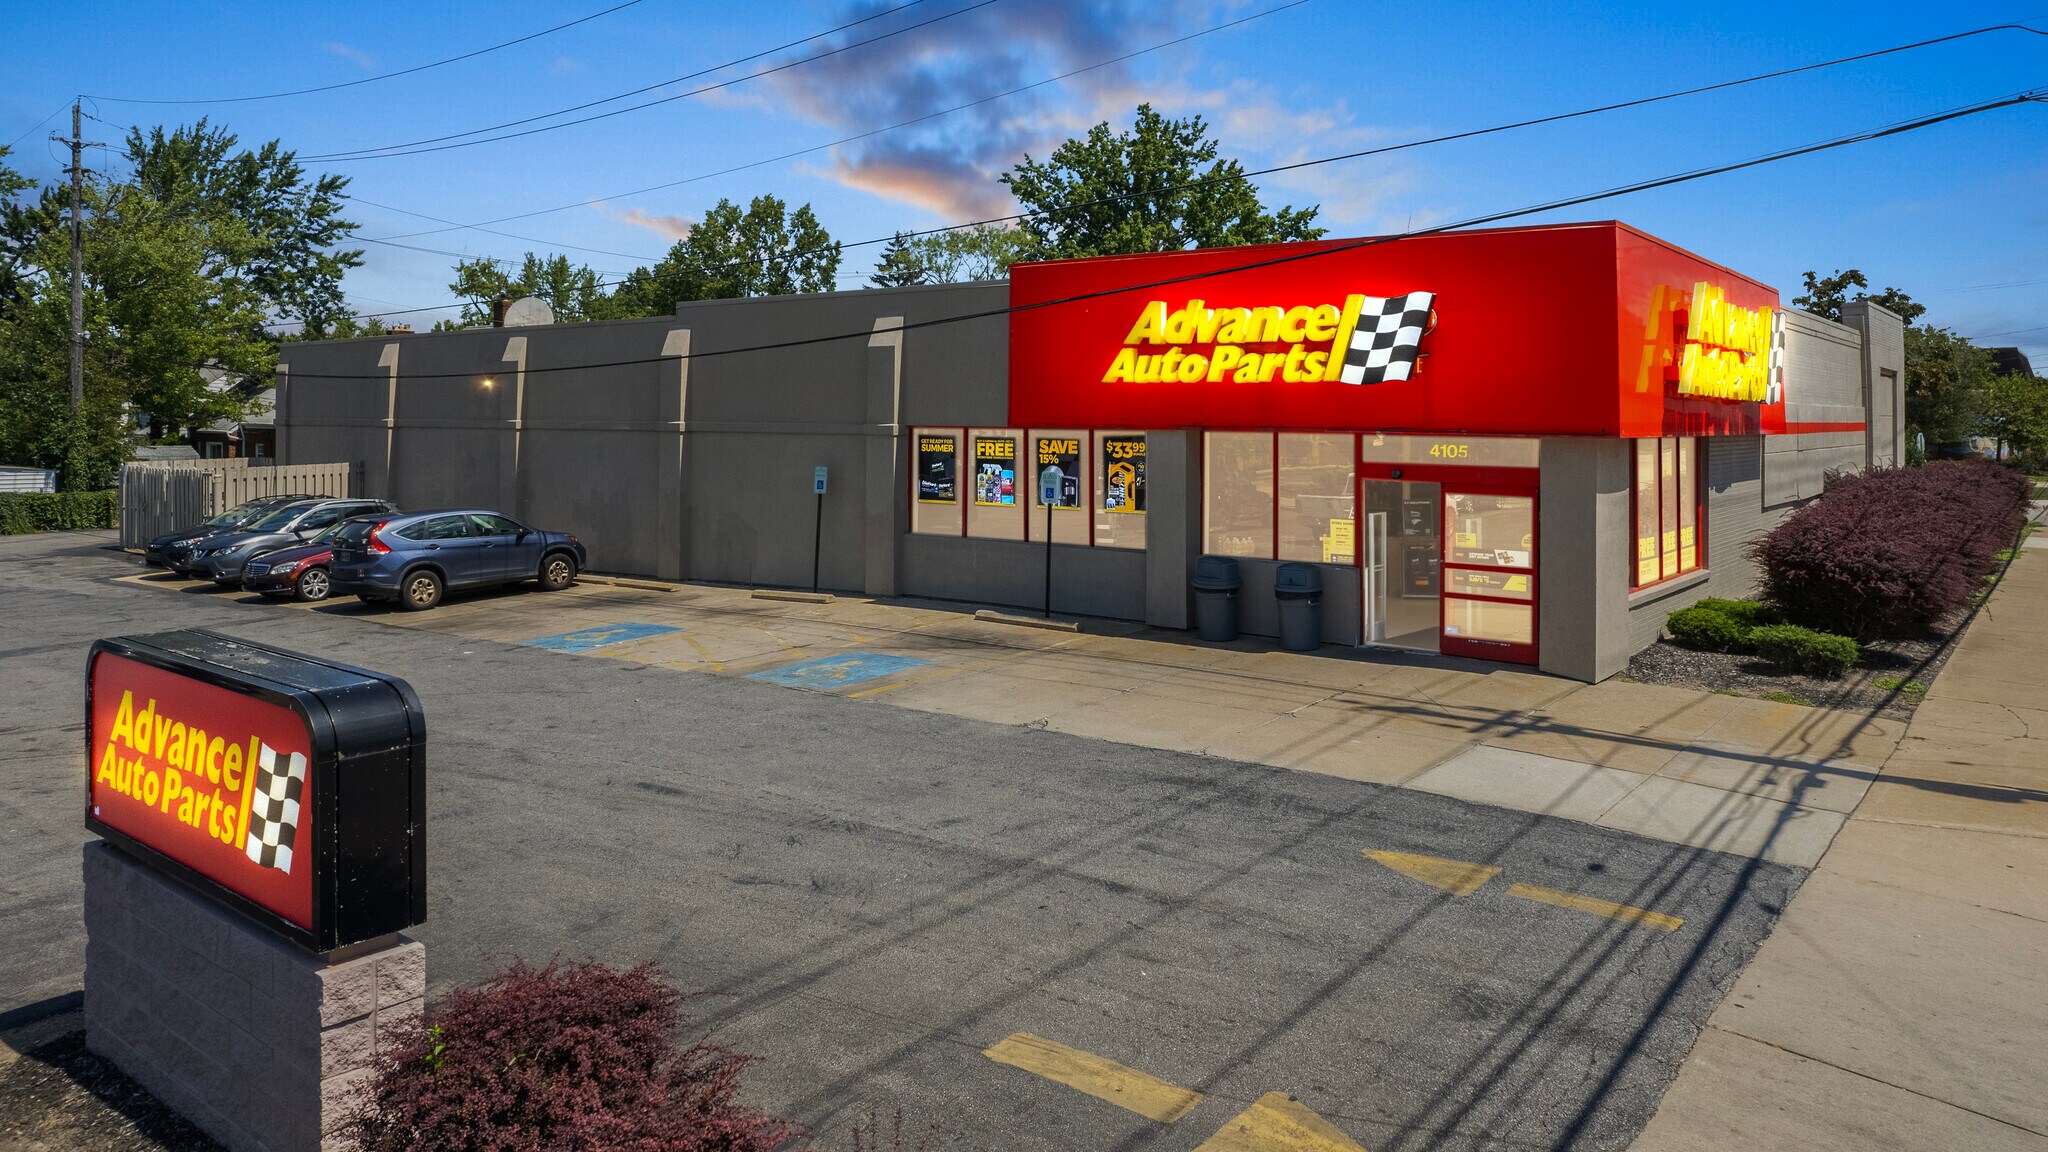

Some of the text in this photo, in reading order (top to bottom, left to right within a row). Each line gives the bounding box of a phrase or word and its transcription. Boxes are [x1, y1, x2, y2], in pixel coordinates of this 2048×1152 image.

[1123, 299, 1340, 345] Advance
[1101, 344, 1328, 384] Auto Parts
[921, 444, 954, 453] SUMMER
[977, 442, 1014, 457] FREE
[1039, 439, 1078, 454] SAVE
[1429, 444, 1468, 458] 4105
[1039, 454, 1059, 464] 15%
[110, 689, 243, 792] Advance
[96, 742, 237, 845] Auto Parts
